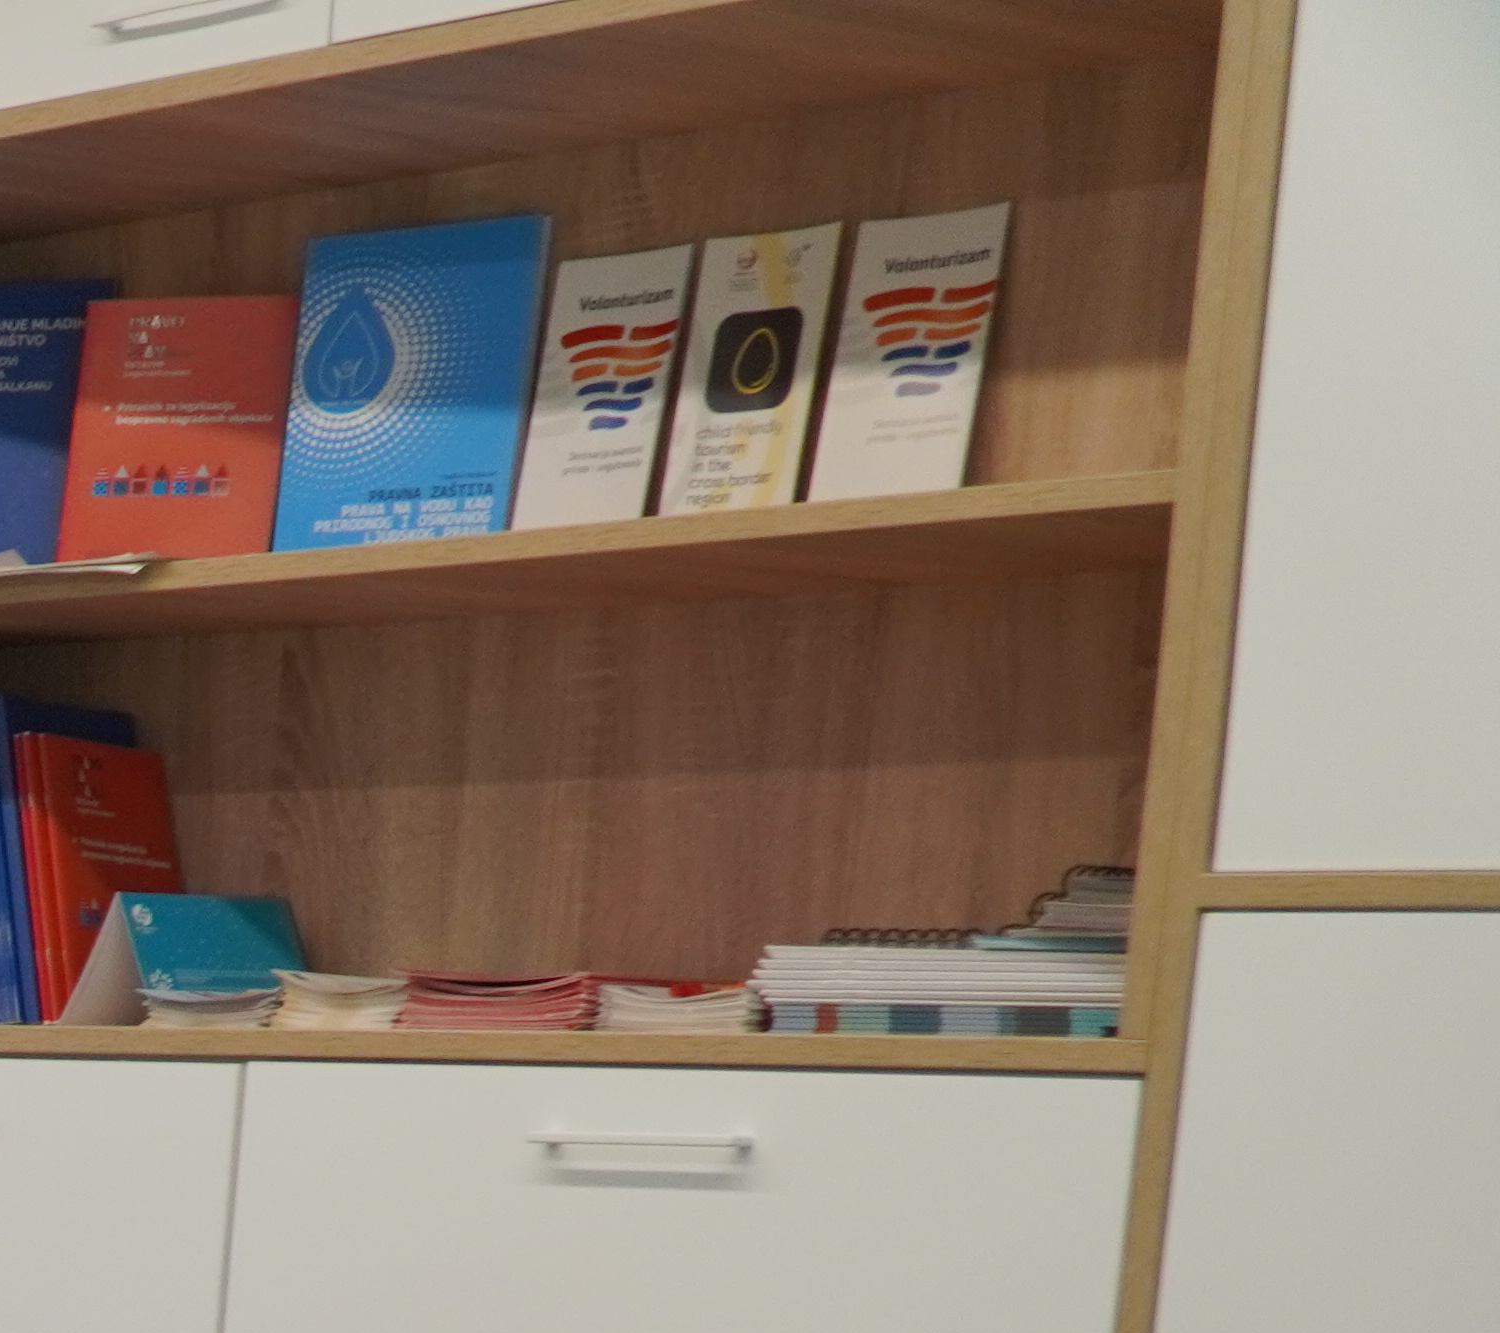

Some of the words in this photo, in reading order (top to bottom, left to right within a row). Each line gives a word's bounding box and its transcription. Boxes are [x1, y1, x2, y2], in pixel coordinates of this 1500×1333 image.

[884, 249, 992, 274] Volonturizam
[579, 287, 675, 312] Volonturizam
[368, 487, 422, 501] PRAVNA
[392, 501, 412, 514] NA
